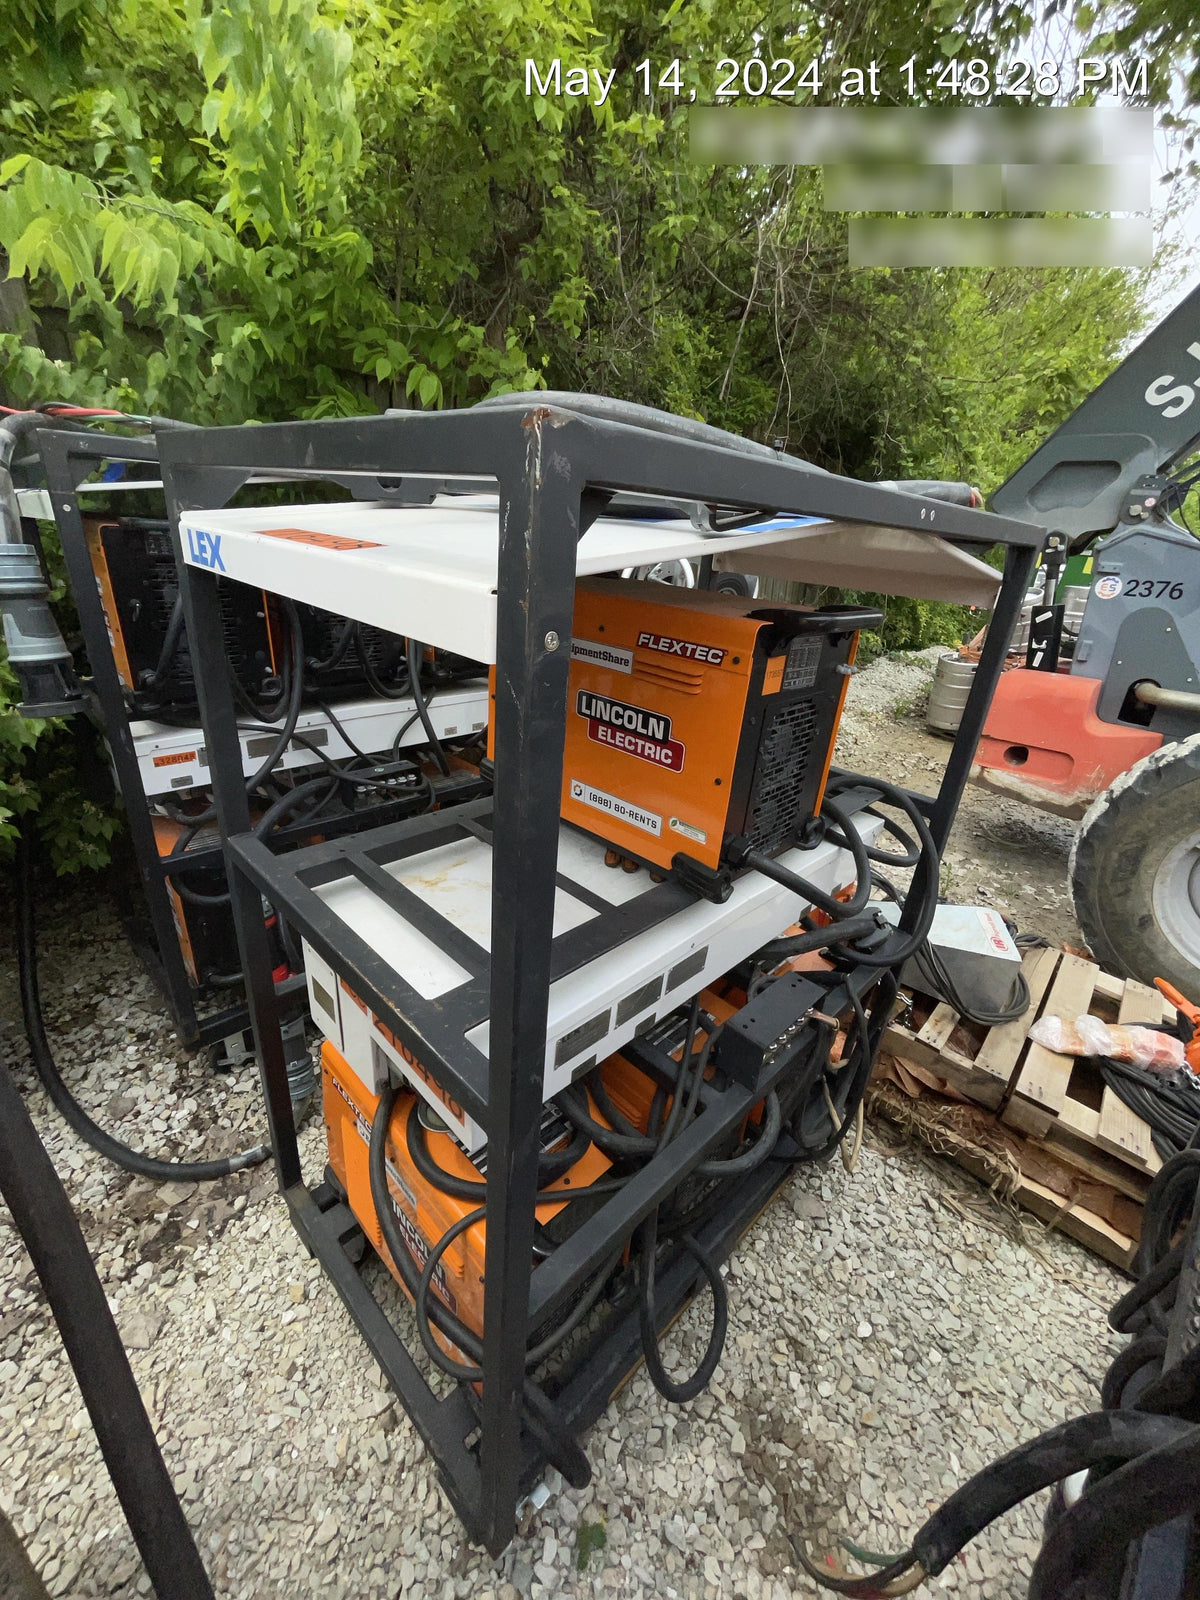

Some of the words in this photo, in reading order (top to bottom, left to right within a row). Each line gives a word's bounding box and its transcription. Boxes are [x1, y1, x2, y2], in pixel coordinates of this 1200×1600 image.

[1145, 341, 1200, 418] S
[187, 528, 226, 572] LEX
[1123, 579, 1184, 600] 2376
[571, 643, 630, 667] ipmentShare
[638, 633, 724, 665] FLEXTEC
[581, 695, 666, 740] LINCOLN
[598, 725, 673, 765] ELECTRIC
[589, 792, 612, 809] (888)
[614, 803, 658, 829] 80-RENTS
[332, 1077, 373, 1133] FLEXTEC
